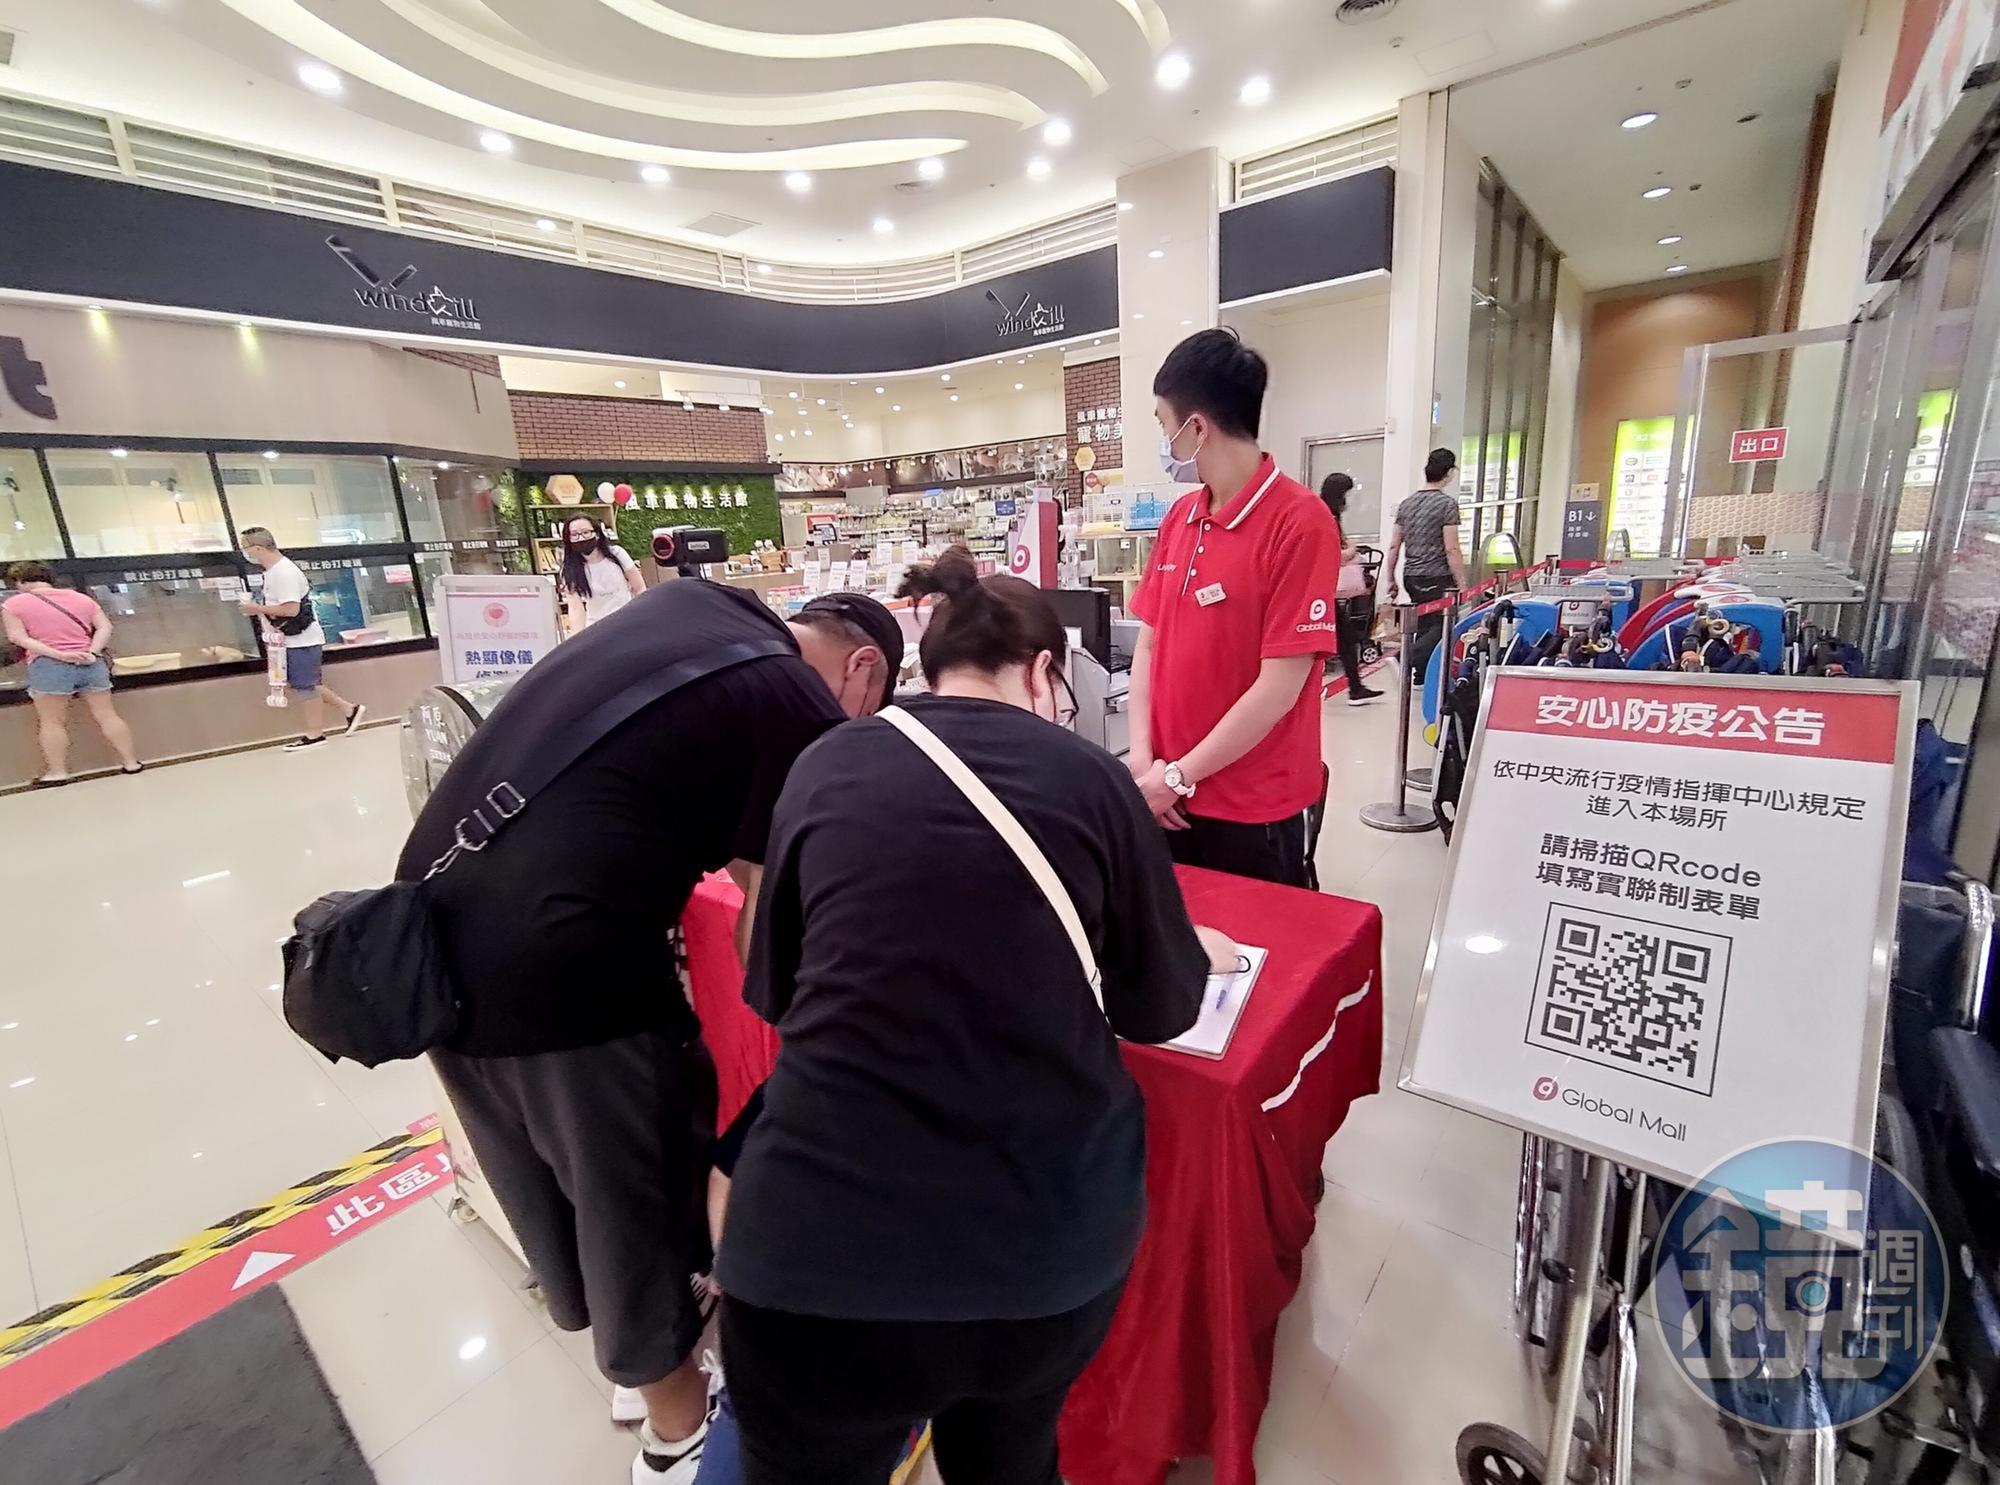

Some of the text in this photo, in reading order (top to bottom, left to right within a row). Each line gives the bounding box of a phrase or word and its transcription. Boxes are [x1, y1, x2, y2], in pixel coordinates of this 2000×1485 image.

[1738, 435, 1780, 455] 出口
[1568, 510, 1583, 522] B1
[465, 650, 533, 665] 熱顯像儀
[1535, 693, 1825, 746] 安心防疫公告
[1493, 759, 1866, 821] 依中央流行疫情指揮中心規定
[1585, 794, 1727, 831] 進入本場所
[1540, 832, 1762, 887] 請掃描QRcode
[1536, 861, 1760, 921] 填寫實聯制表單
[1562, 1088, 1686, 1142] Global Mall
